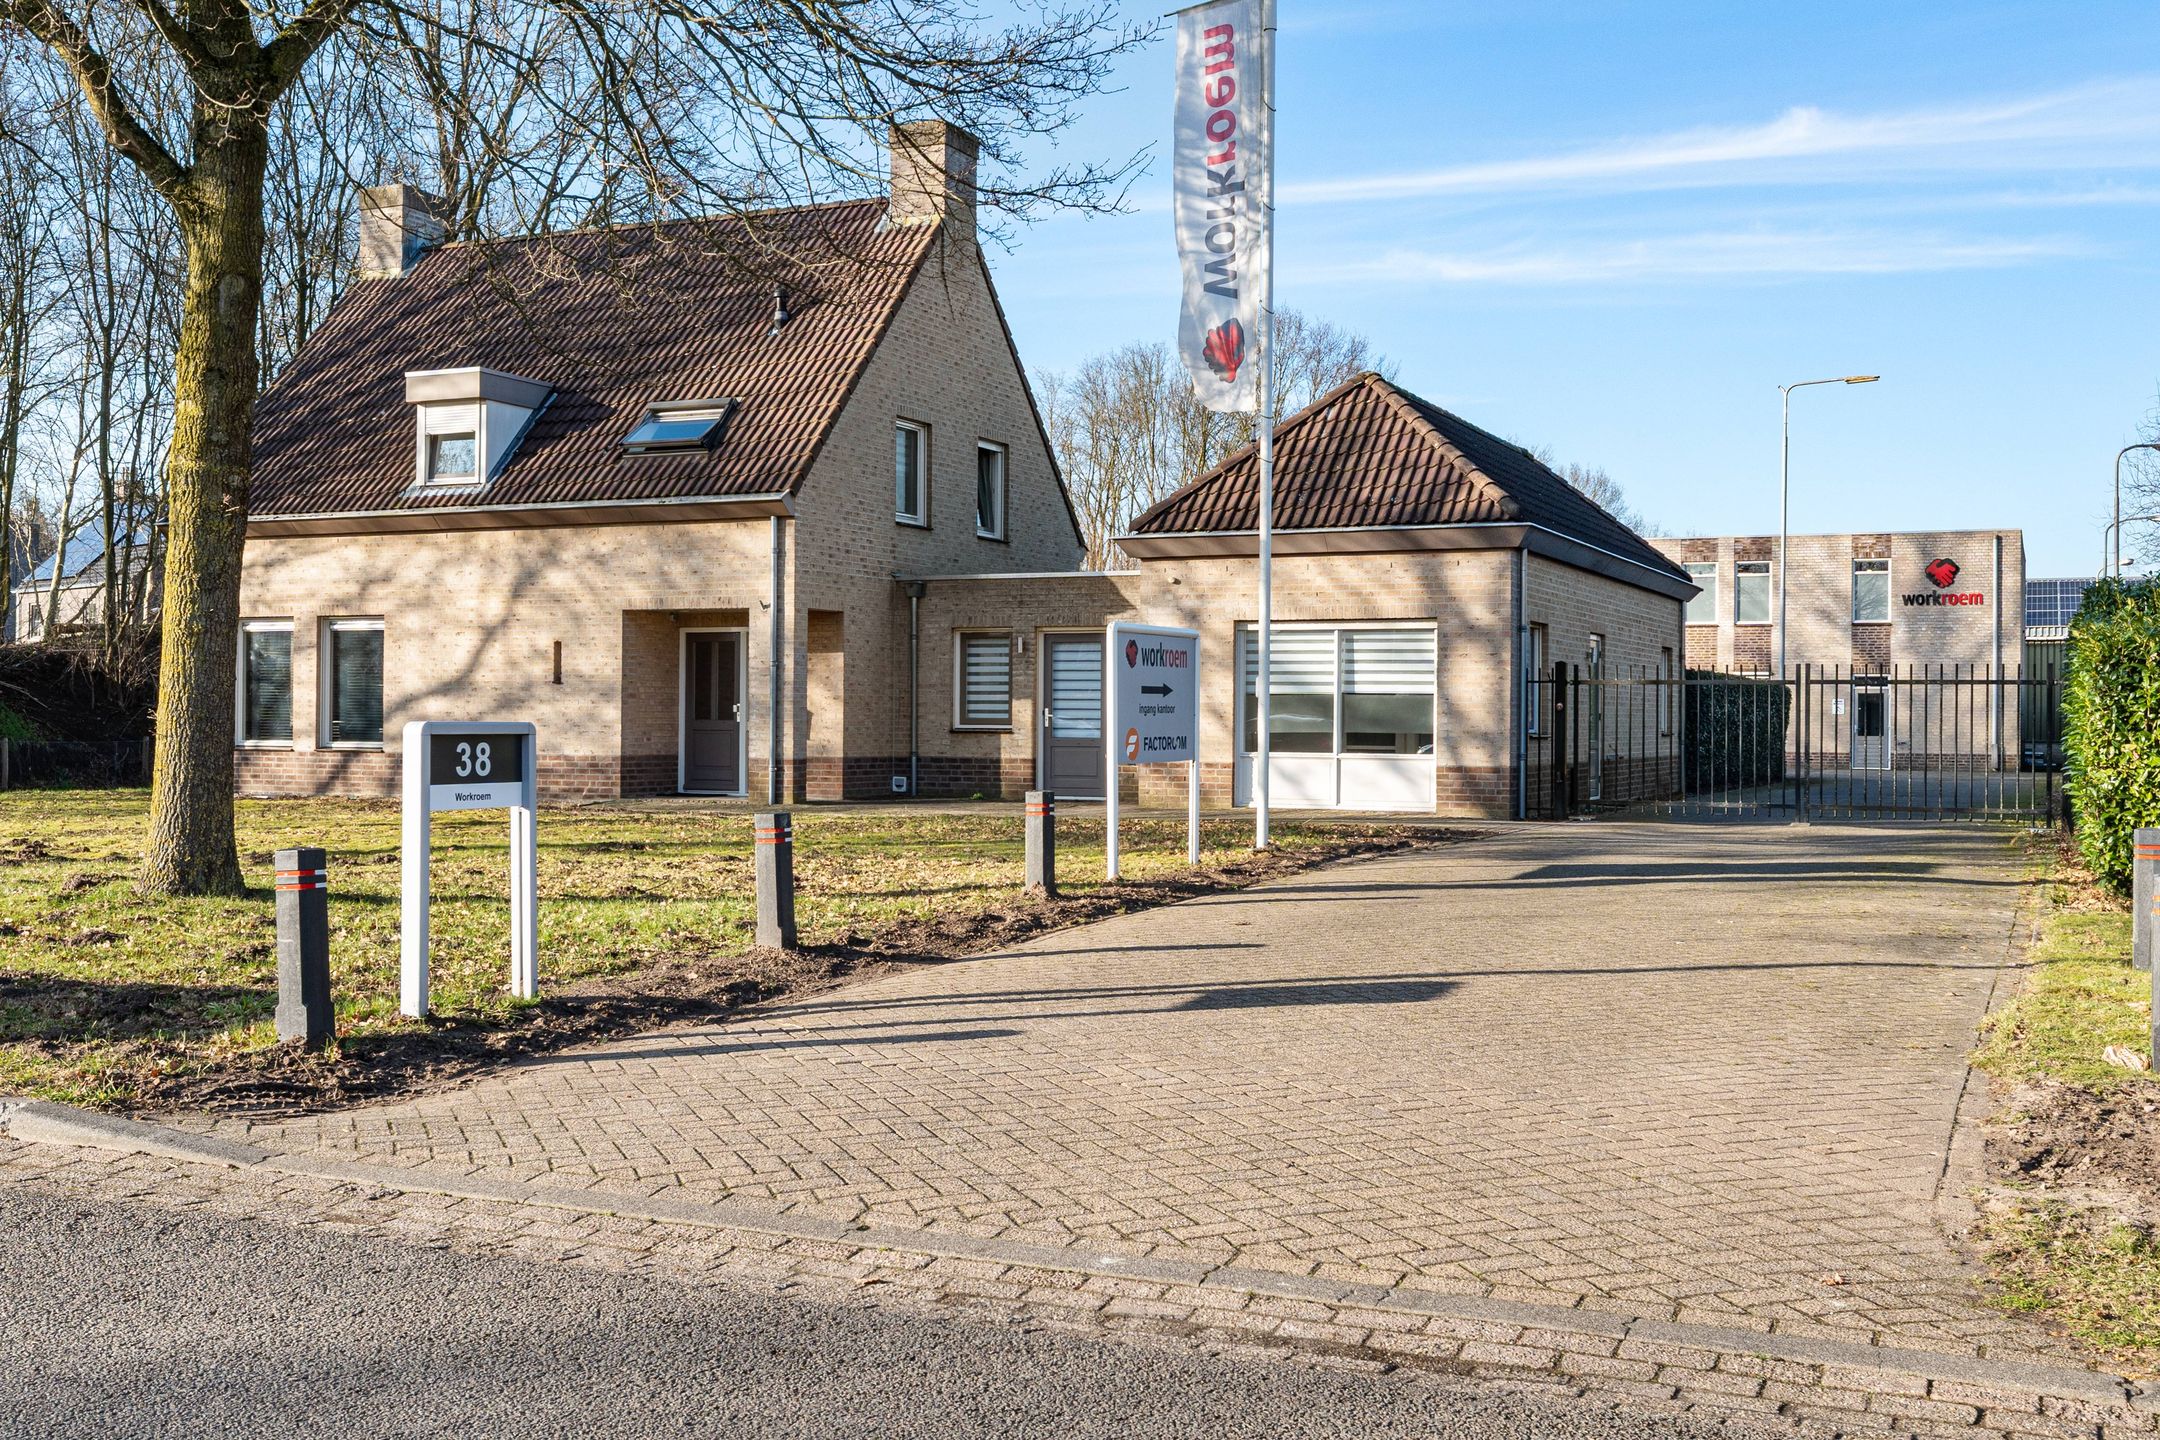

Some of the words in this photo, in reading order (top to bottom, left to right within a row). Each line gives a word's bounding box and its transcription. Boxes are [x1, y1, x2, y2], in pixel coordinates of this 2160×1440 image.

[1901, 590, 1984, 607] workroem
[1141, 642, 1188, 668] workroem
[1138, 703, 1156, 717] ingang
[1156, 703, 1176, 714] kantoor
[455, 742, 492, 777] 38
[455, 792, 492, 802] Workroem
